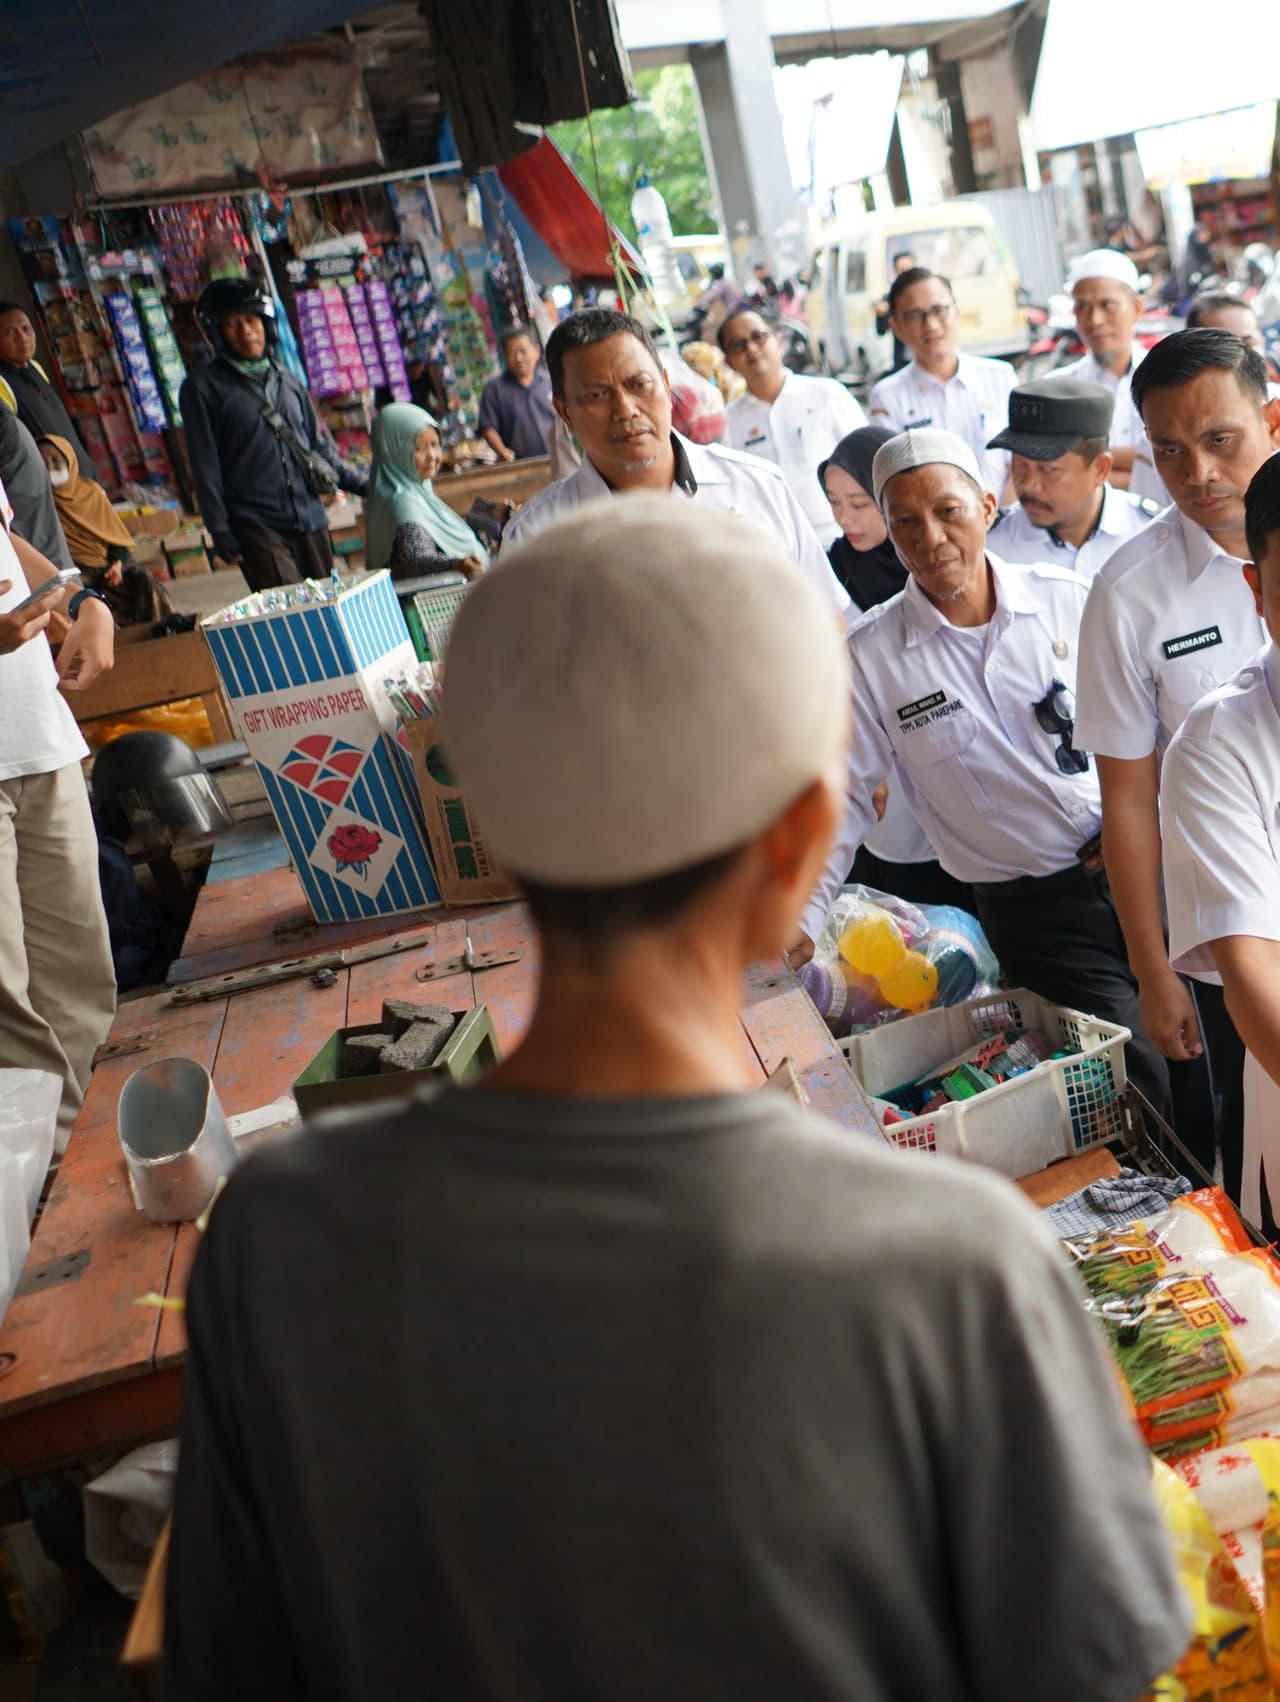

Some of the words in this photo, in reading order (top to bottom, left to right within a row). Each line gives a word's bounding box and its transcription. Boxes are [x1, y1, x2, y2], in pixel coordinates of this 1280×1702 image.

[1167, 631, 1217, 654] HERMANTO
[243, 708, 270, 734] GIFT
[270, 697, 330, 730] WRAPPING
[327, 687, 368, 716] PAPER
